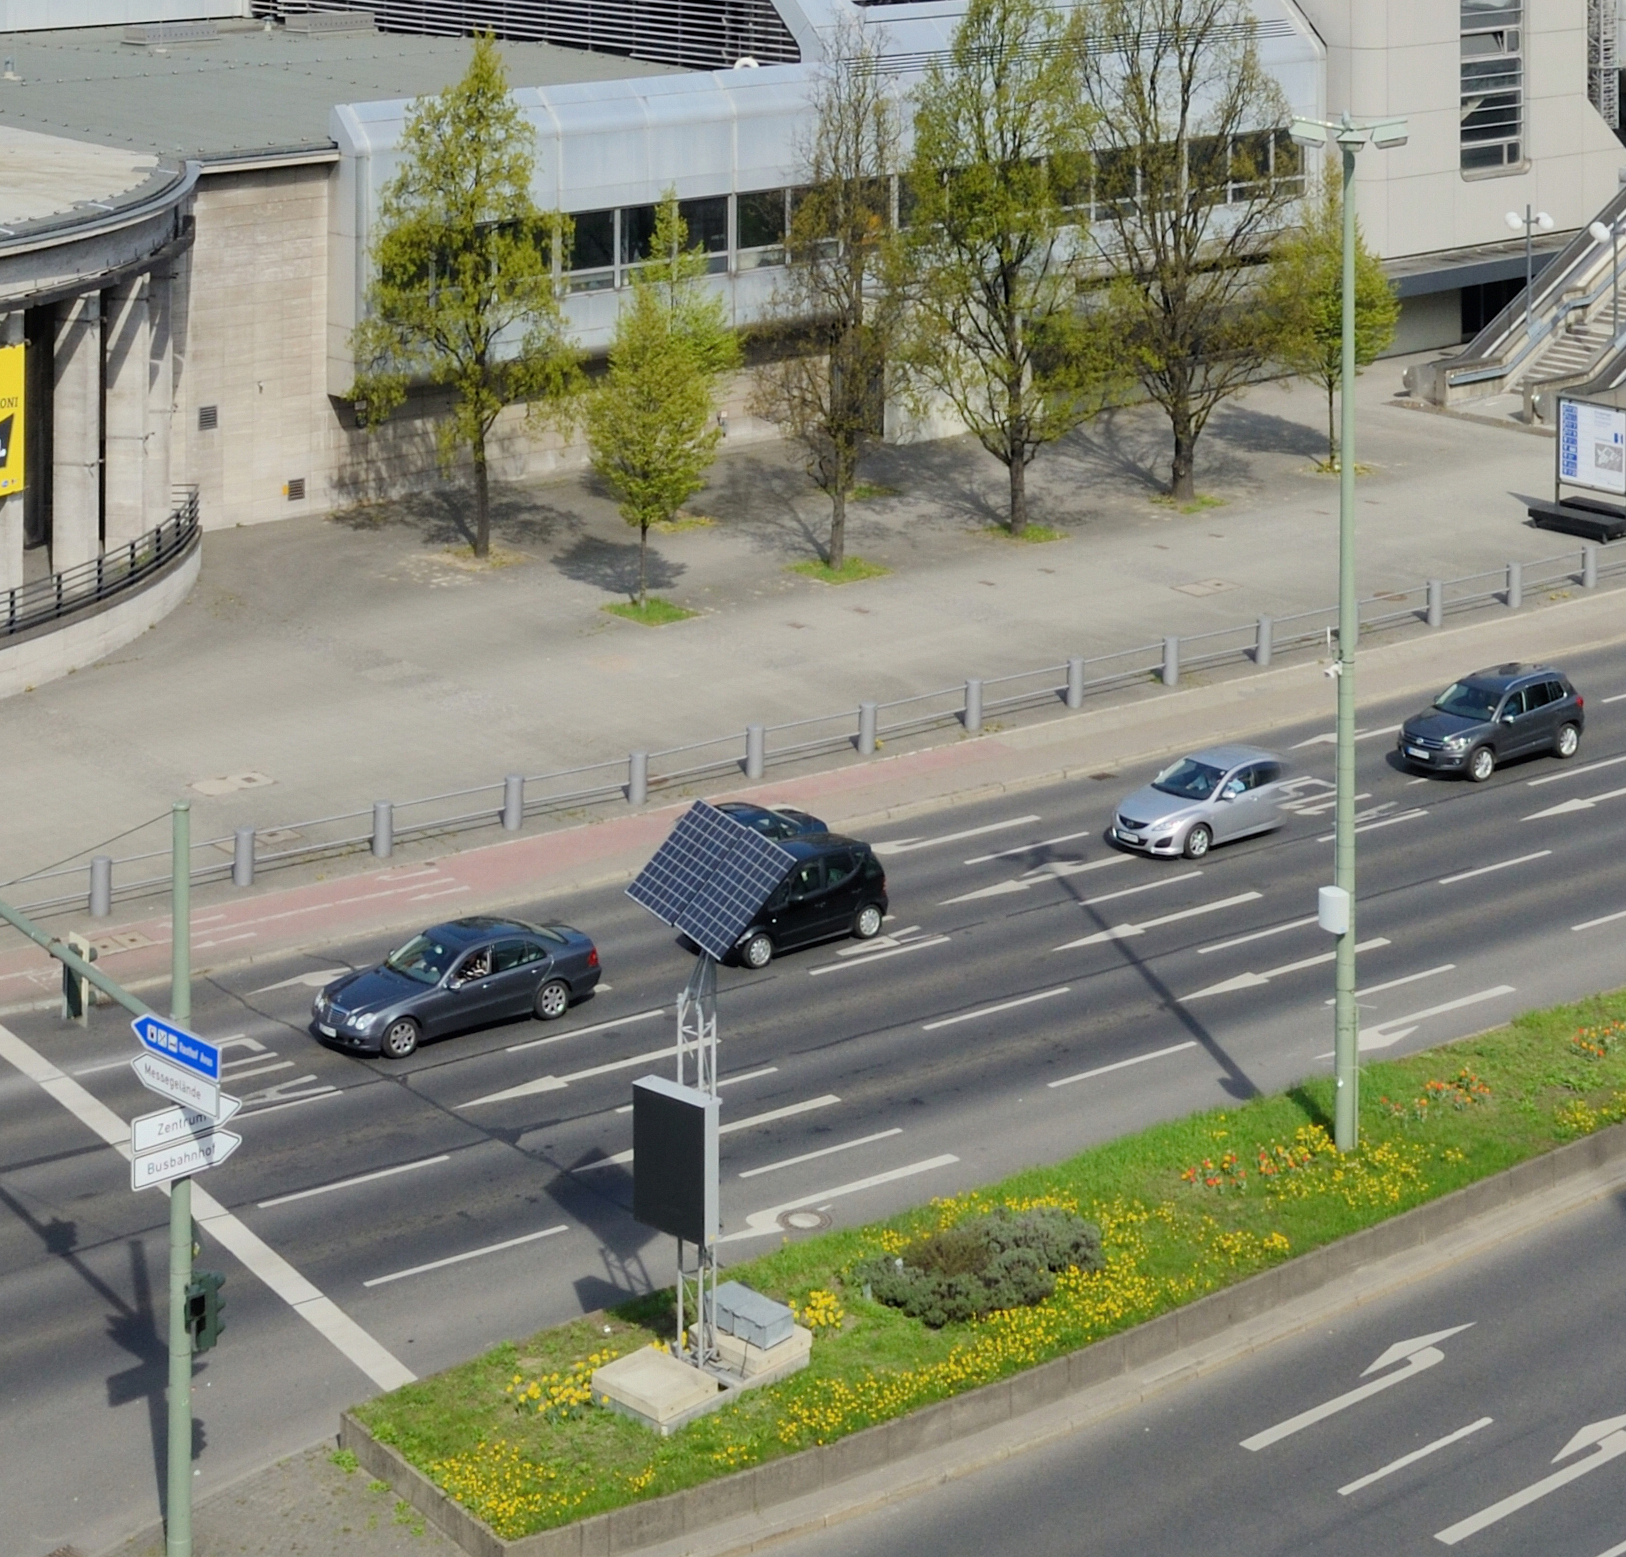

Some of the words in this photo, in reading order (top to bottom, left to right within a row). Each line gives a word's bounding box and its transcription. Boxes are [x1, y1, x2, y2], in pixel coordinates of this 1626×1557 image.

[144, 1063, 202, 1101] Messegelände
[157, 1113, 207, 1136] Zentrum
[147, 1143, 216, 1175] Busbahnhof
